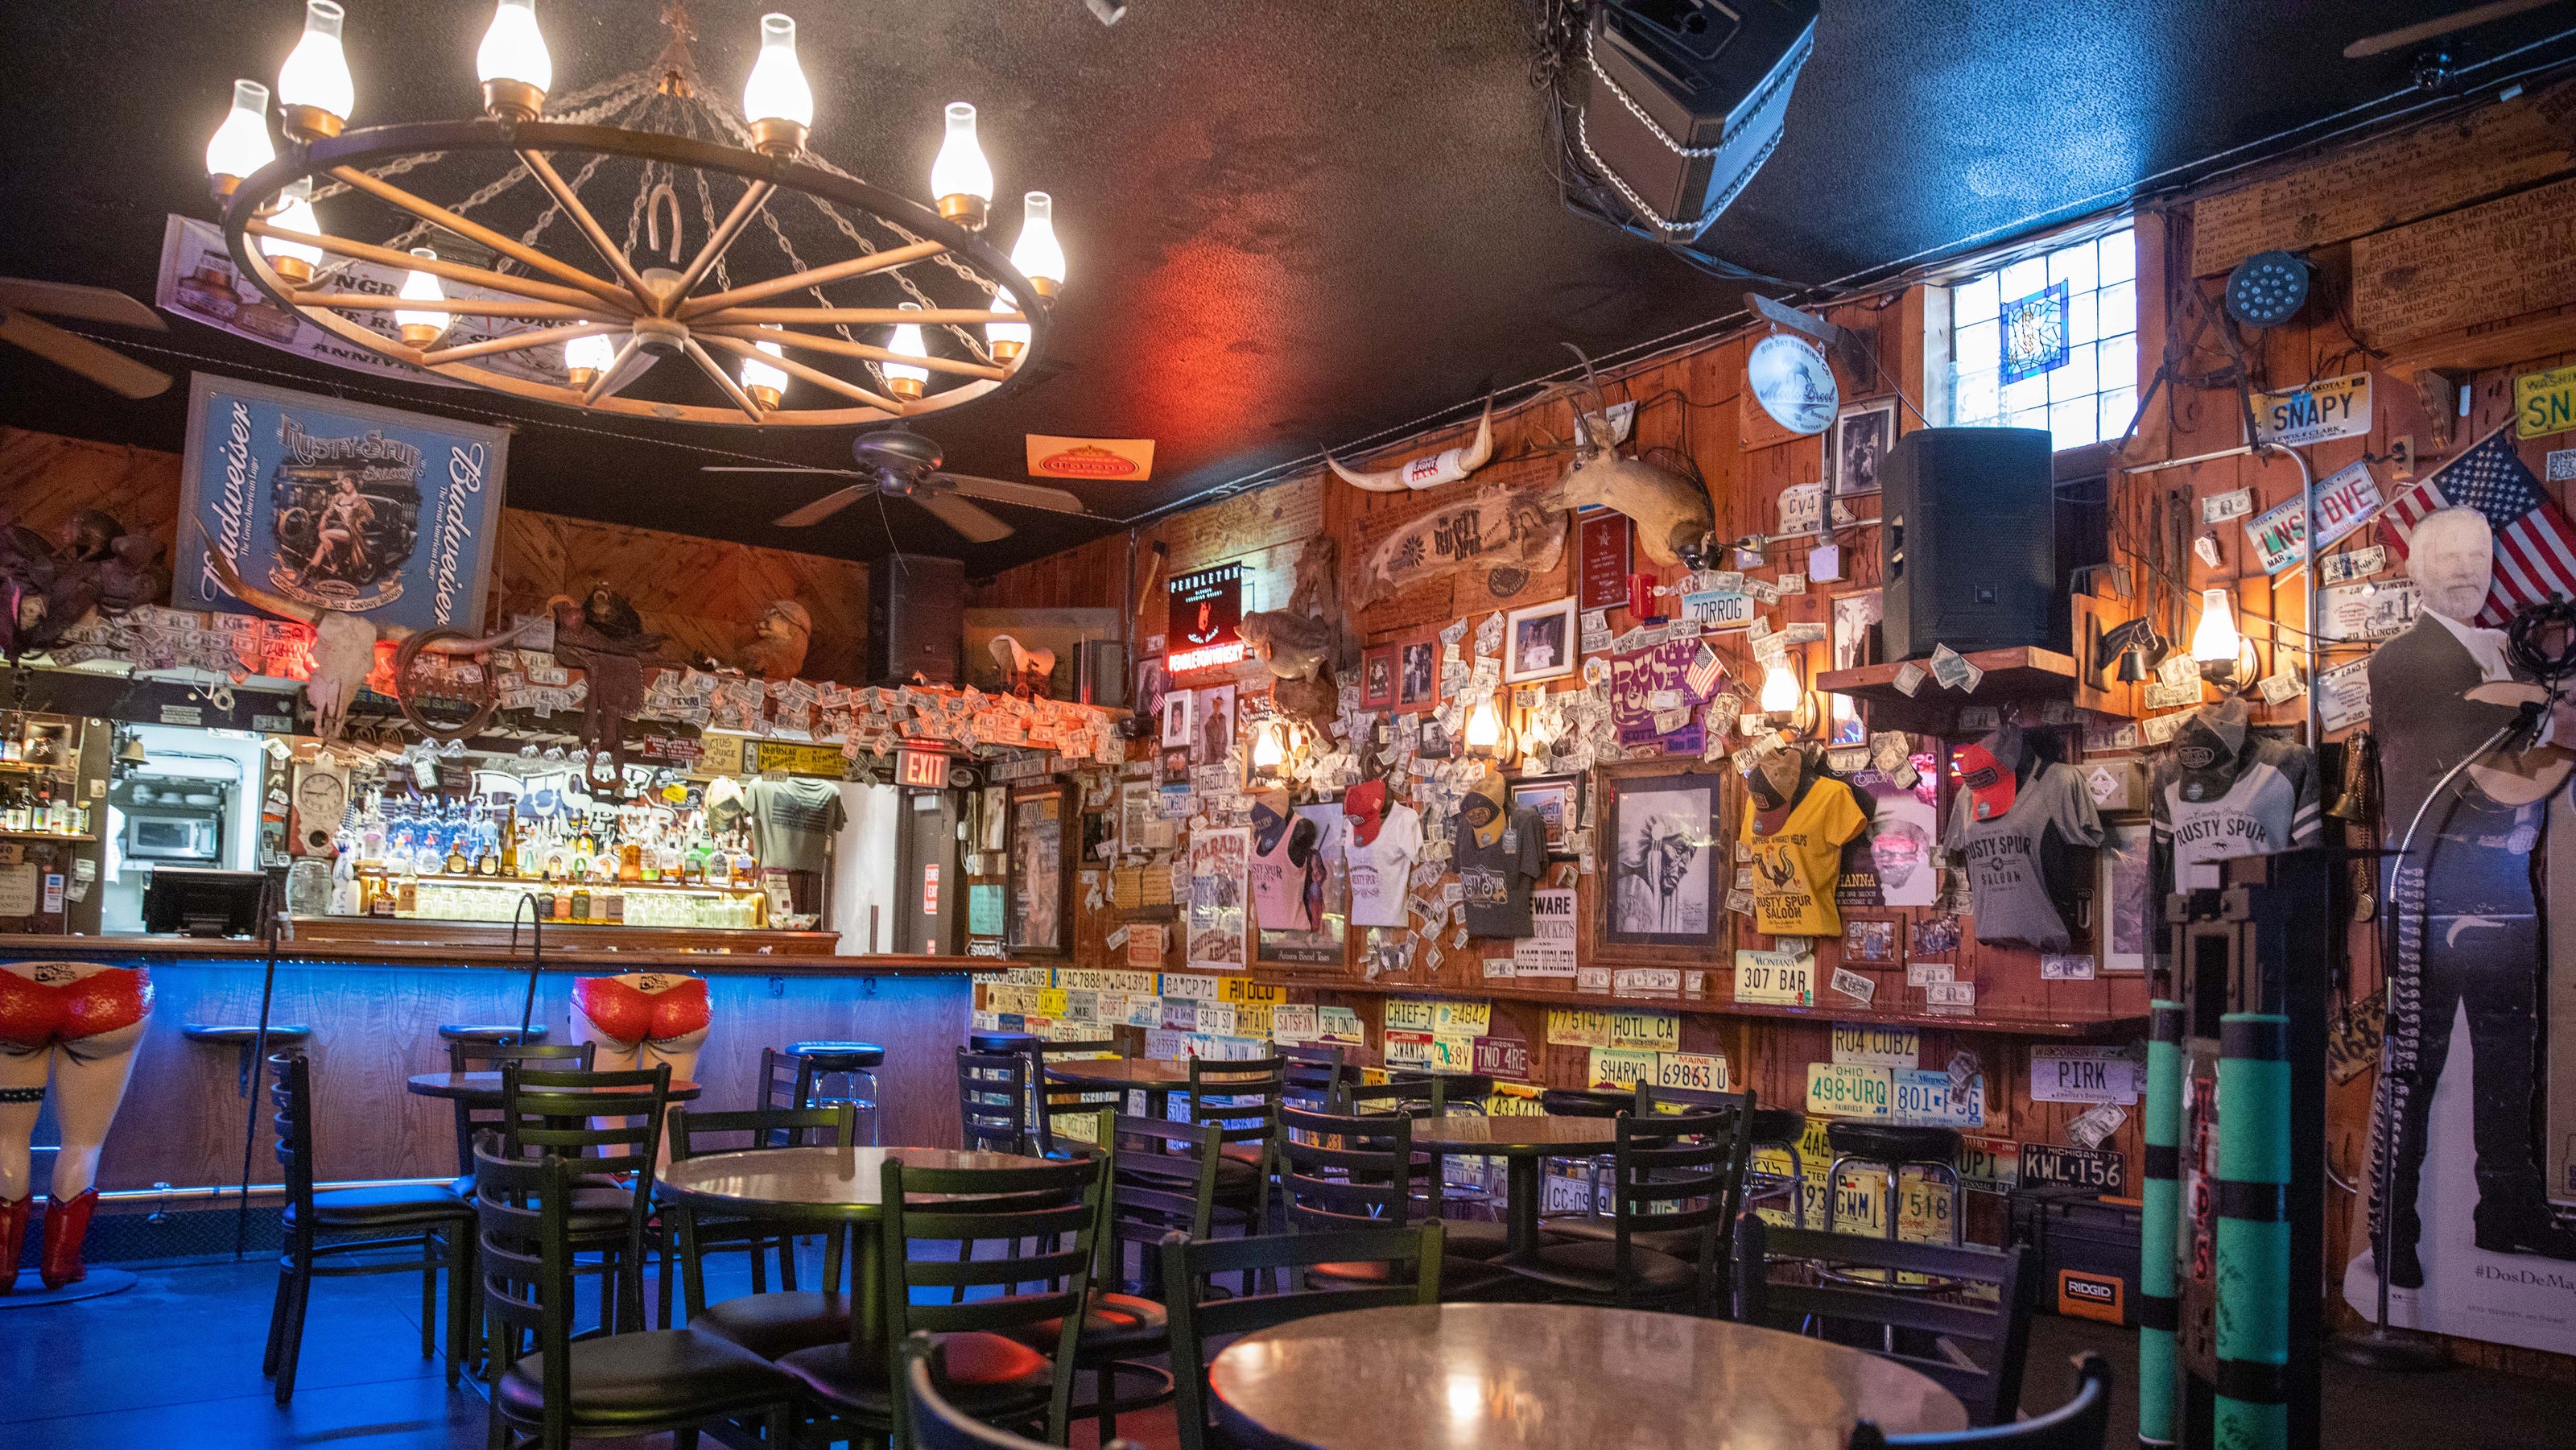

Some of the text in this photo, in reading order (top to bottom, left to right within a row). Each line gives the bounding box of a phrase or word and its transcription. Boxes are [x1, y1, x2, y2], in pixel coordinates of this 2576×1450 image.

[2273, 392, 2353, 431] SNAPY
[2529, 389, 2576, 427] SN
[436, 443, 484, 626] Budweiser
[2267, 554, 2285, 568] MAR
[1170, 565, 1240, 593] PENDLETON
[709, 737, 733, 748] CTUS
[907, 751, 944, 787] EXIT
[2175, 818, 2267, 846] RUSTY SPUR
[1998, 835, 2032, 856] SPUR
[1980, 870, 2022, 886] SALOON
[1529, 896, 1571, 915] EWARE
[1757, 894, 1811, 907] RUSTY SPUR
[1765, 907, 1802, 919] SALOON
[1755, 956, 1795, 968] MONTANA
[1744, 967, 1806, 993] 307 BAR
[1200, 1010, 1231, 1029] SAID SO
[1278, 1014, 1313, 1033] SATSFXN
[1387, 1003, 1434, 1026] CHIEF-7
[1613, 1016, 1674, 1039] HOTL CA
[1393, 1041, 1426, 1060] SWANYS
[1490, 1040, 1516, 1048] ARIZONA
[1873, 1031, 1914, 1056] CUBZ
[1504, 1046, 1527, 1072] 4RE
[1678, 1055, 1711, 1065] MAINE
[1662, 1063, 1711, 1089] 69863
[1835, 1066, 1864, 1077] OHIO
[1918, 1074, 1952, 1085] Minneso
[2058, 1060, 2107, 1090] PIRK
[1835, 1103, 1864, 1113] FAIRFIELD
[1897, 1085, 1932, 1112] 801
[2046, 1146, 2099, 1160] MICHIGAN
[1961, 1181, 1992, 1192] TENNIAL
[2068, 1280, 2112, 1298] RIDGID
